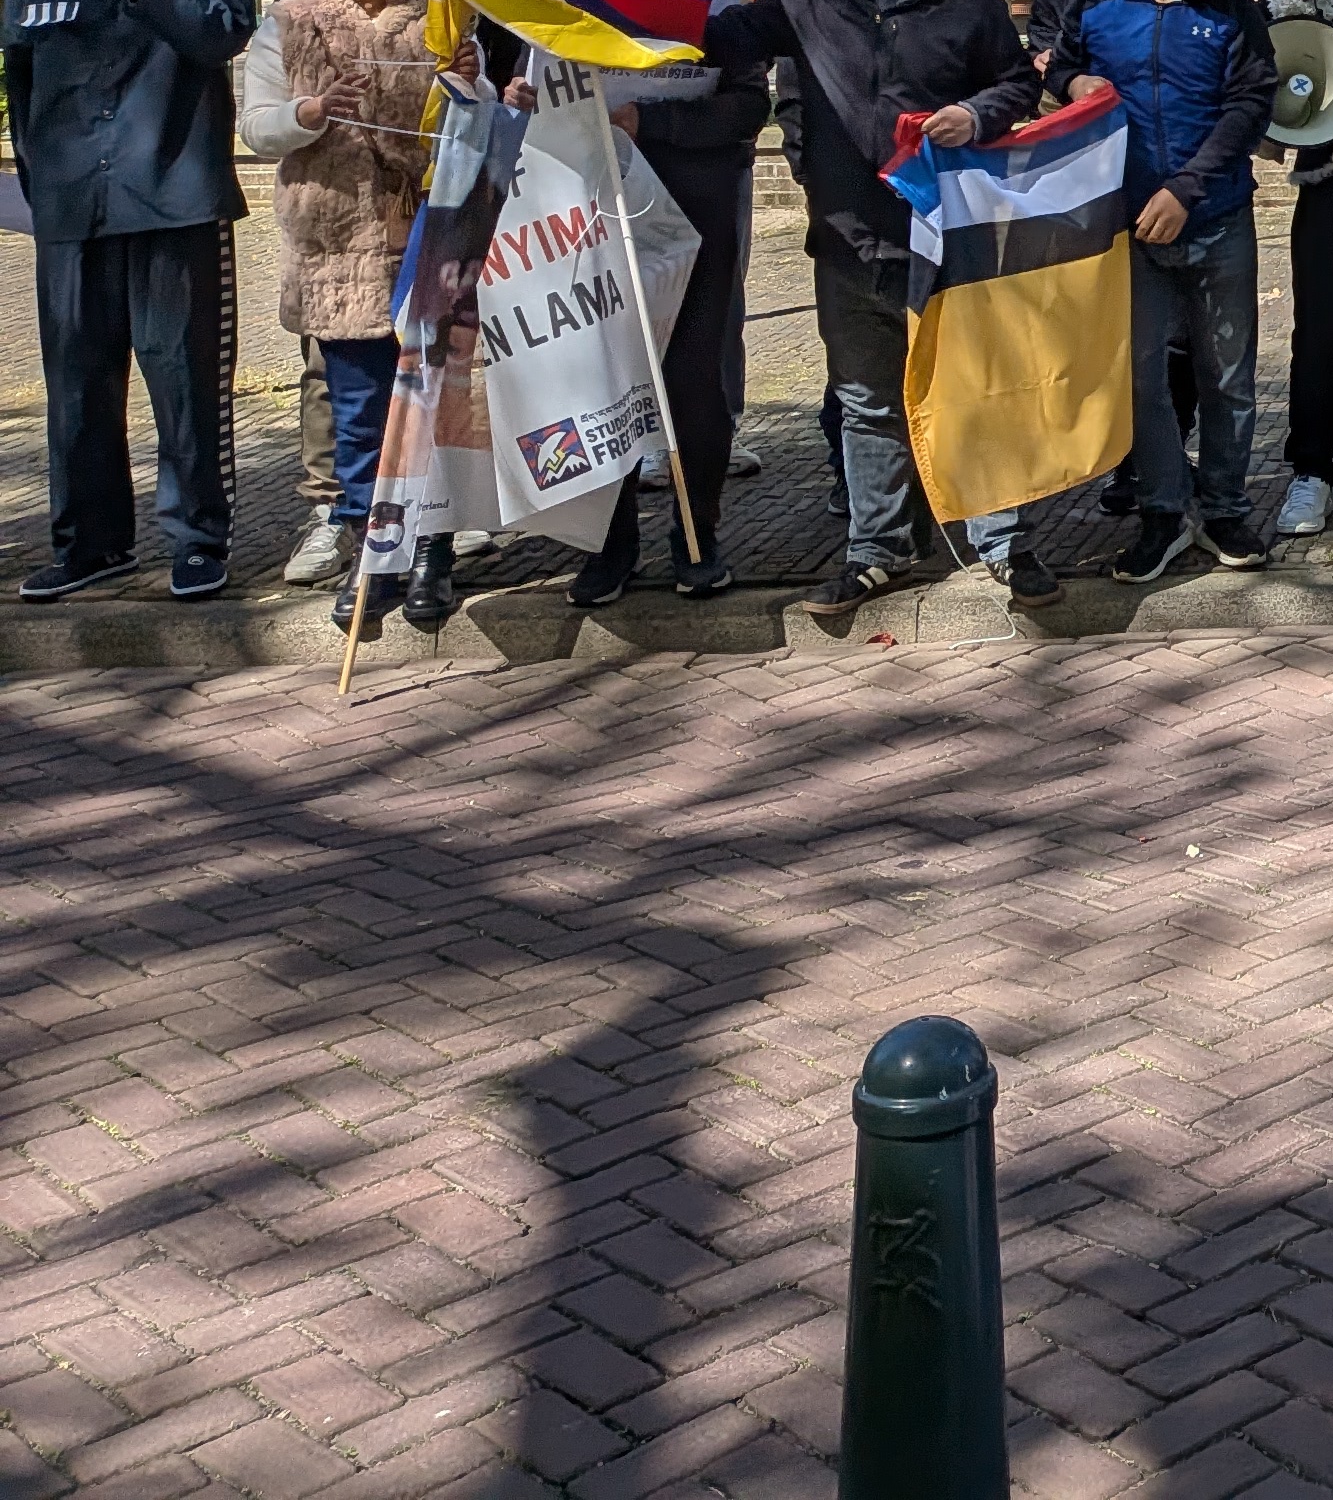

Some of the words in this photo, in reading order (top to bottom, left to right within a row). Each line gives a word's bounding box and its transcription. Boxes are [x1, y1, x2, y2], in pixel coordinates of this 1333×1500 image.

[534, 60, 595, 114] HE
[513, 269, 625, 348] LAMA
[628, 411, 660, 447] TIBE
[417, 498, 450, 511] erland
